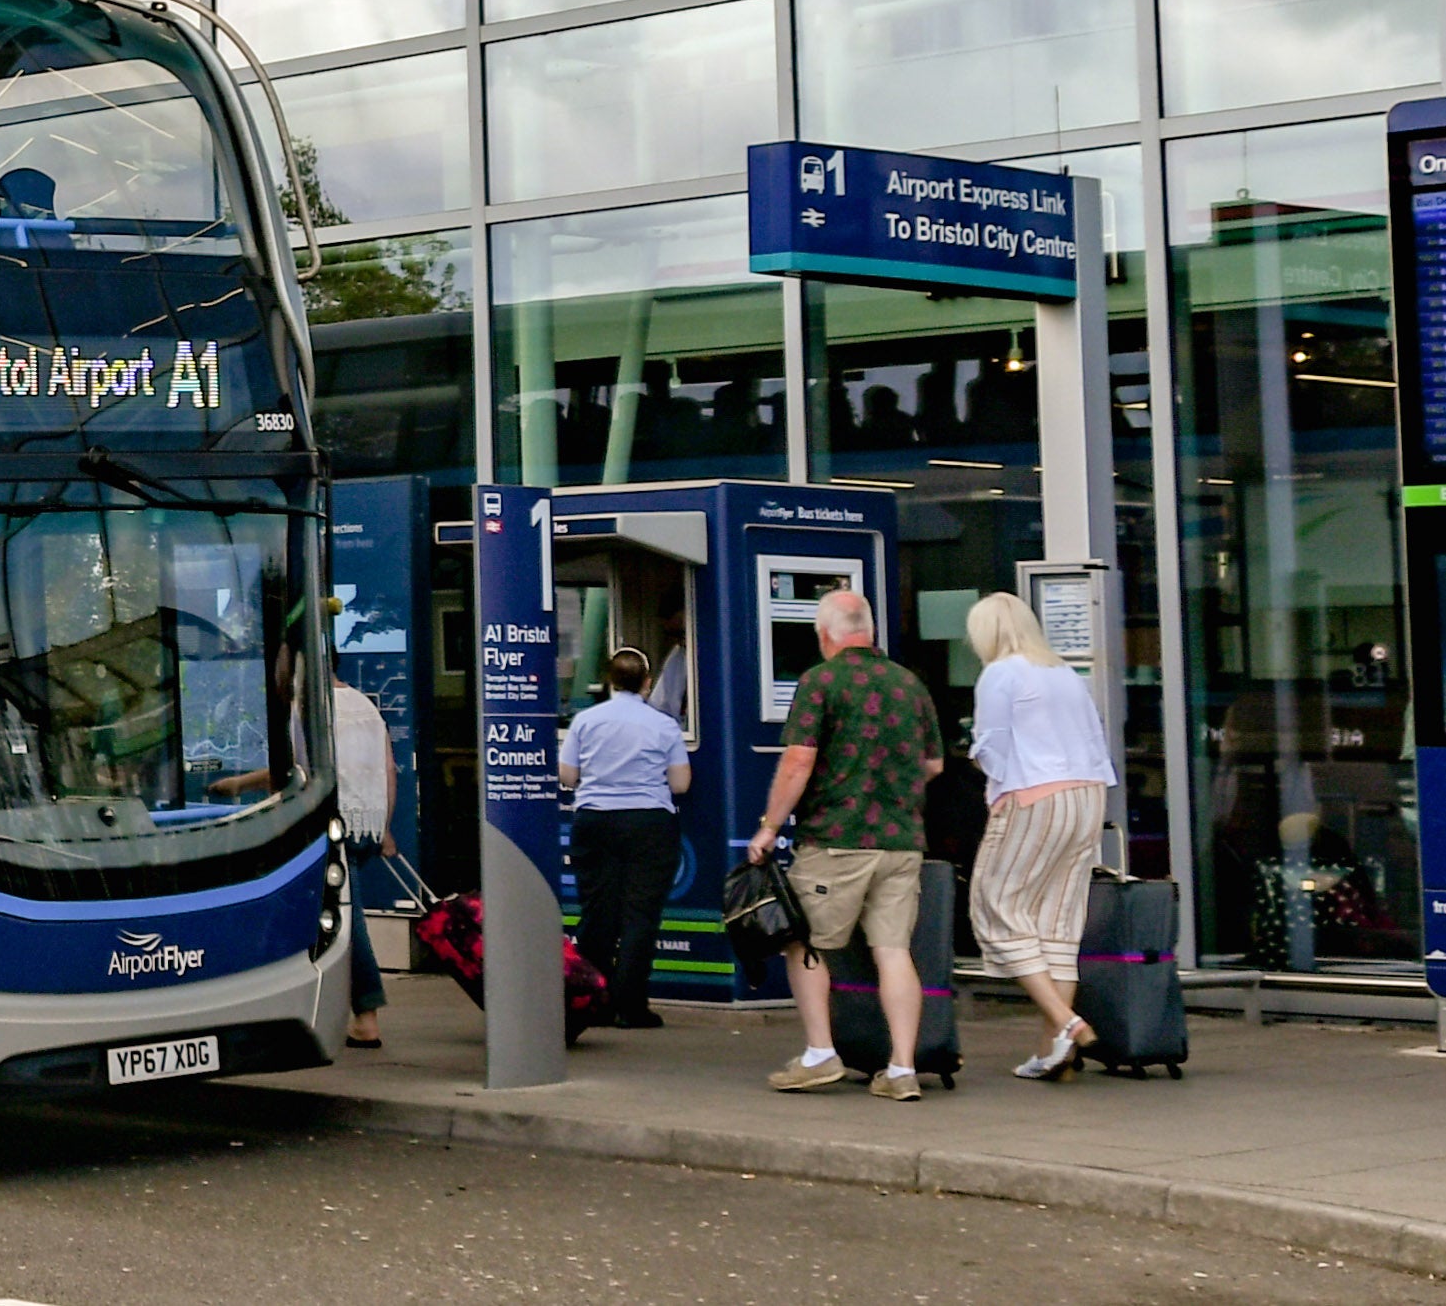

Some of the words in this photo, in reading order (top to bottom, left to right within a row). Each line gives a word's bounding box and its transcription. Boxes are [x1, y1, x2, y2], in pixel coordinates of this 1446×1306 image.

[1419, 155, 1446, 174] On
[825, 150, 846, 196] 1
[886, 170, 955, 201] Airport
[959, 179, 1029, 210] Express
[1032, 188, 1066, 216] Link
[884, 213, 911, 239] To
[916, 216, 979, 246] Bristol
[984, 224, 1019, 257] City
[1023, 230, 1076, 260] Centre
[48, 345, 155, 408] Airport
[166, 340, 219, 408] A1
[255, 413, 294, 432] 36830
[798, 506, 814, 520] Bus
[815, 507, 843, 522] tickets
[844, 509, 864, 522] here
[333, 524, 363, 534] nections
[553, 522, 568, 534] les
[530, 498, 553, 612] 1
[484, 624, 502, 643] A1
[508, 625, 551, 644] Bristol
[484, 647, 525, 670] Flyer
[487, 724, 509, 742] A2
[514, 724, 536, 742] Air
[487, 747, 547, 765] Connect
[107, 945, 205, 980] AirportFlyer
[117, 1046, 167, 1078] YP67
[173, 1041, 210, 1070] XDG
